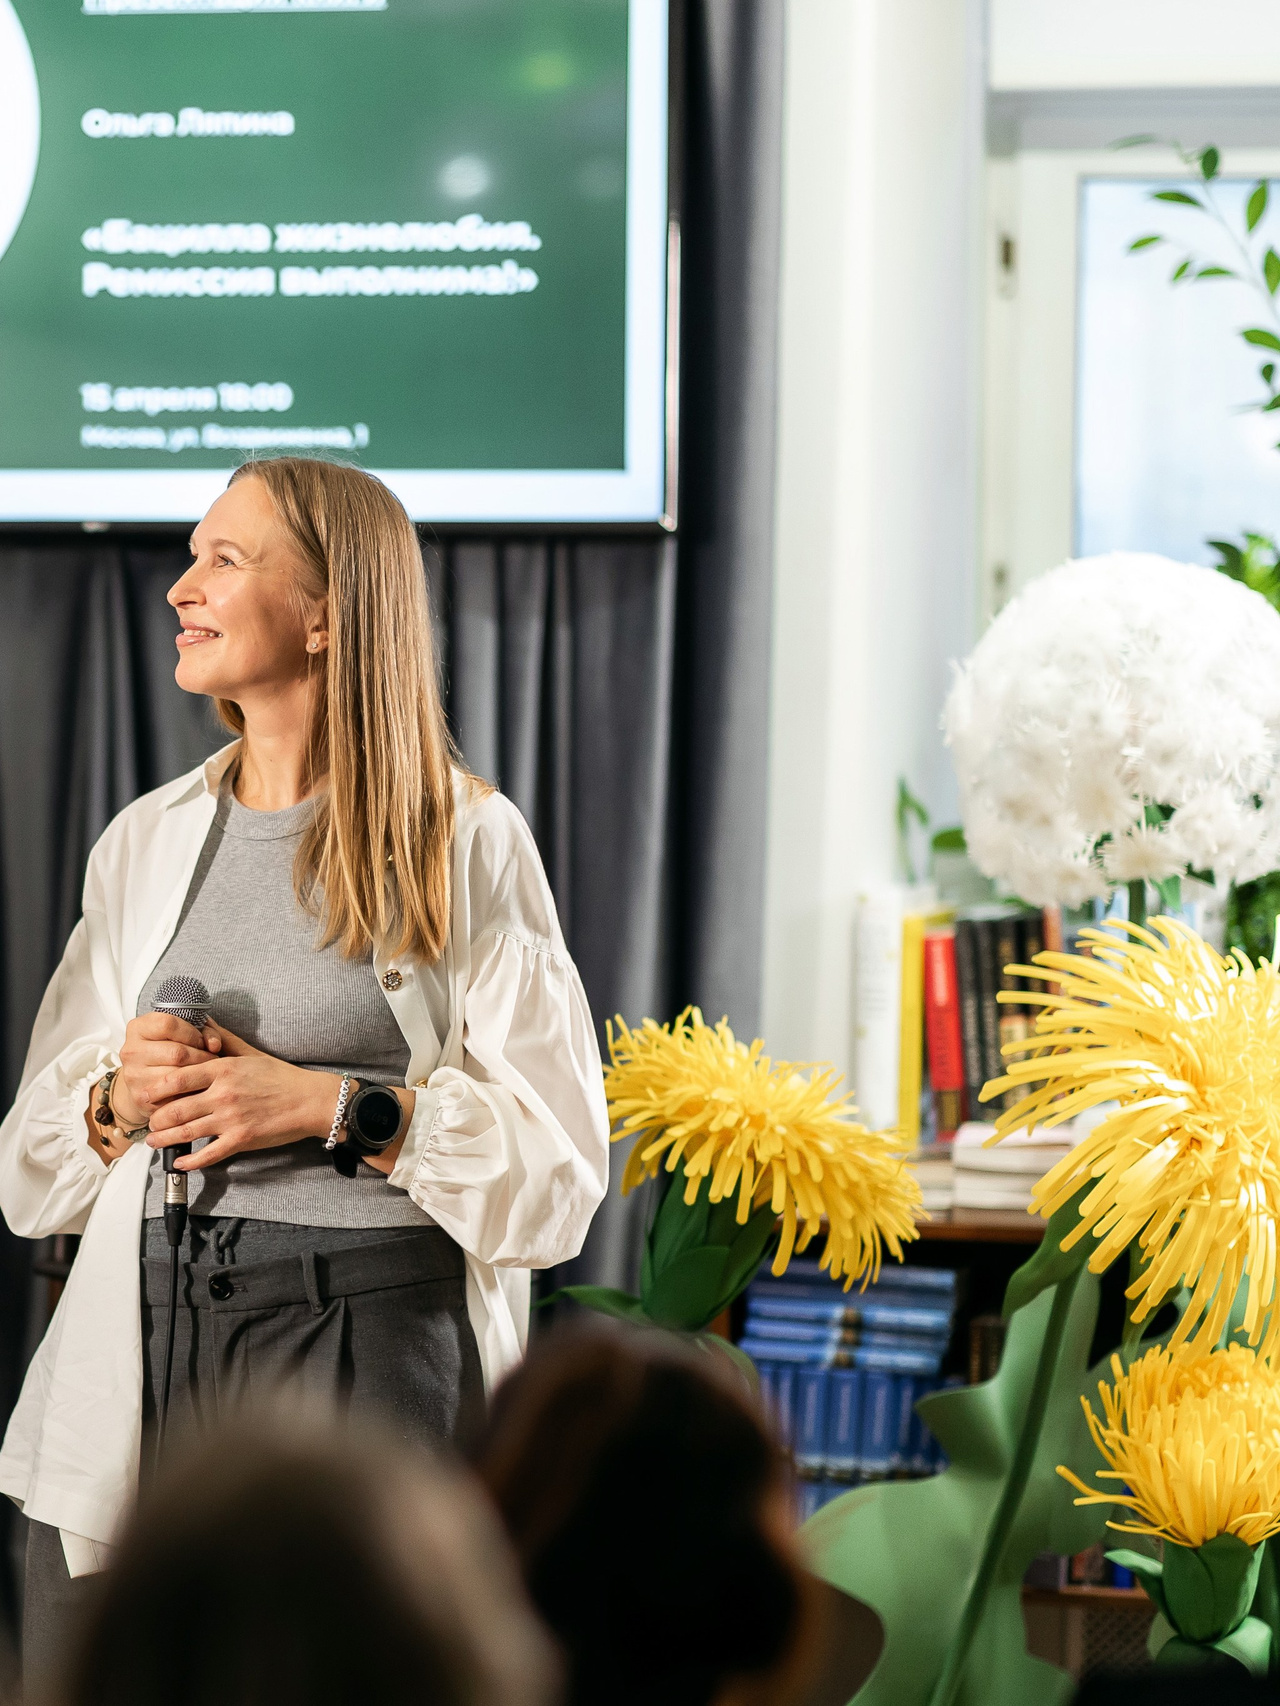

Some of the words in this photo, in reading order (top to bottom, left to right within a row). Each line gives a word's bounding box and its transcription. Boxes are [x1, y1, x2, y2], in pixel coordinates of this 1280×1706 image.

[81, 108, 174, 138] Ольга
[176, 107, 295, 137] Ляпина
[82, 219, 271, 257] «Бацилла
[275, 213, 542, 253] жизнелюбия.
[82, 262, 275, 297] Ремиссия
[279, 259, 539, 296] выполнима!»
[80, 382, 113, 412] 15
[114, 386, 217, 416] апреля
